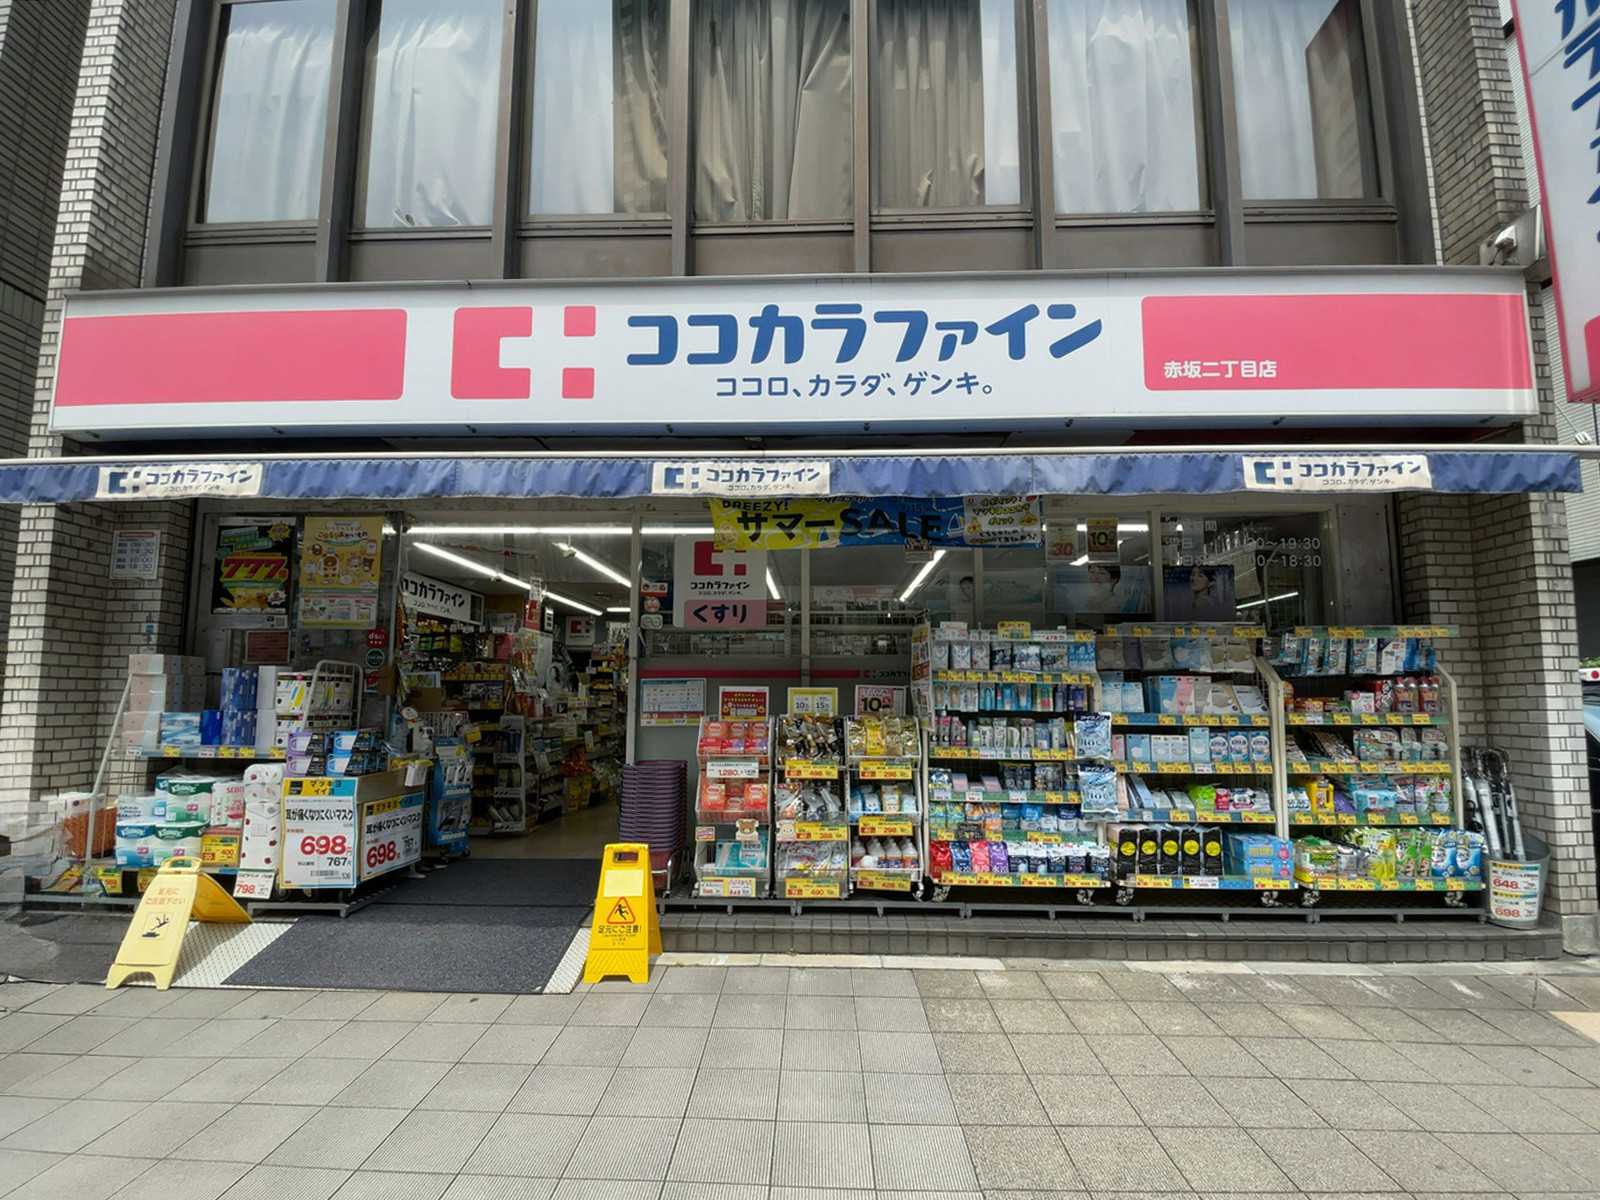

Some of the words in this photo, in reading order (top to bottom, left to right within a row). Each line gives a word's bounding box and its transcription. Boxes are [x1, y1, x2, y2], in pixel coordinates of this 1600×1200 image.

[626, 304, 1103, 366] ココカラファイン
[1163, 360, 1278, 379] 赤坂二丁目店
[715, 371, 995, 399] ココロ、カラダ、ゲンキ。
[146, 468, 253, 486] ココカラファイン
[706, 467, 821, 483] ココカラファイン
[1299, 461, 1421, 477] ココカラファイン
[690, 581, 751, 590] ココカラファイン
[693, 603, 747, 624] くすり
[1493, 878, 1519, 889] 648
[1495, 907, 1520, 918] 698
